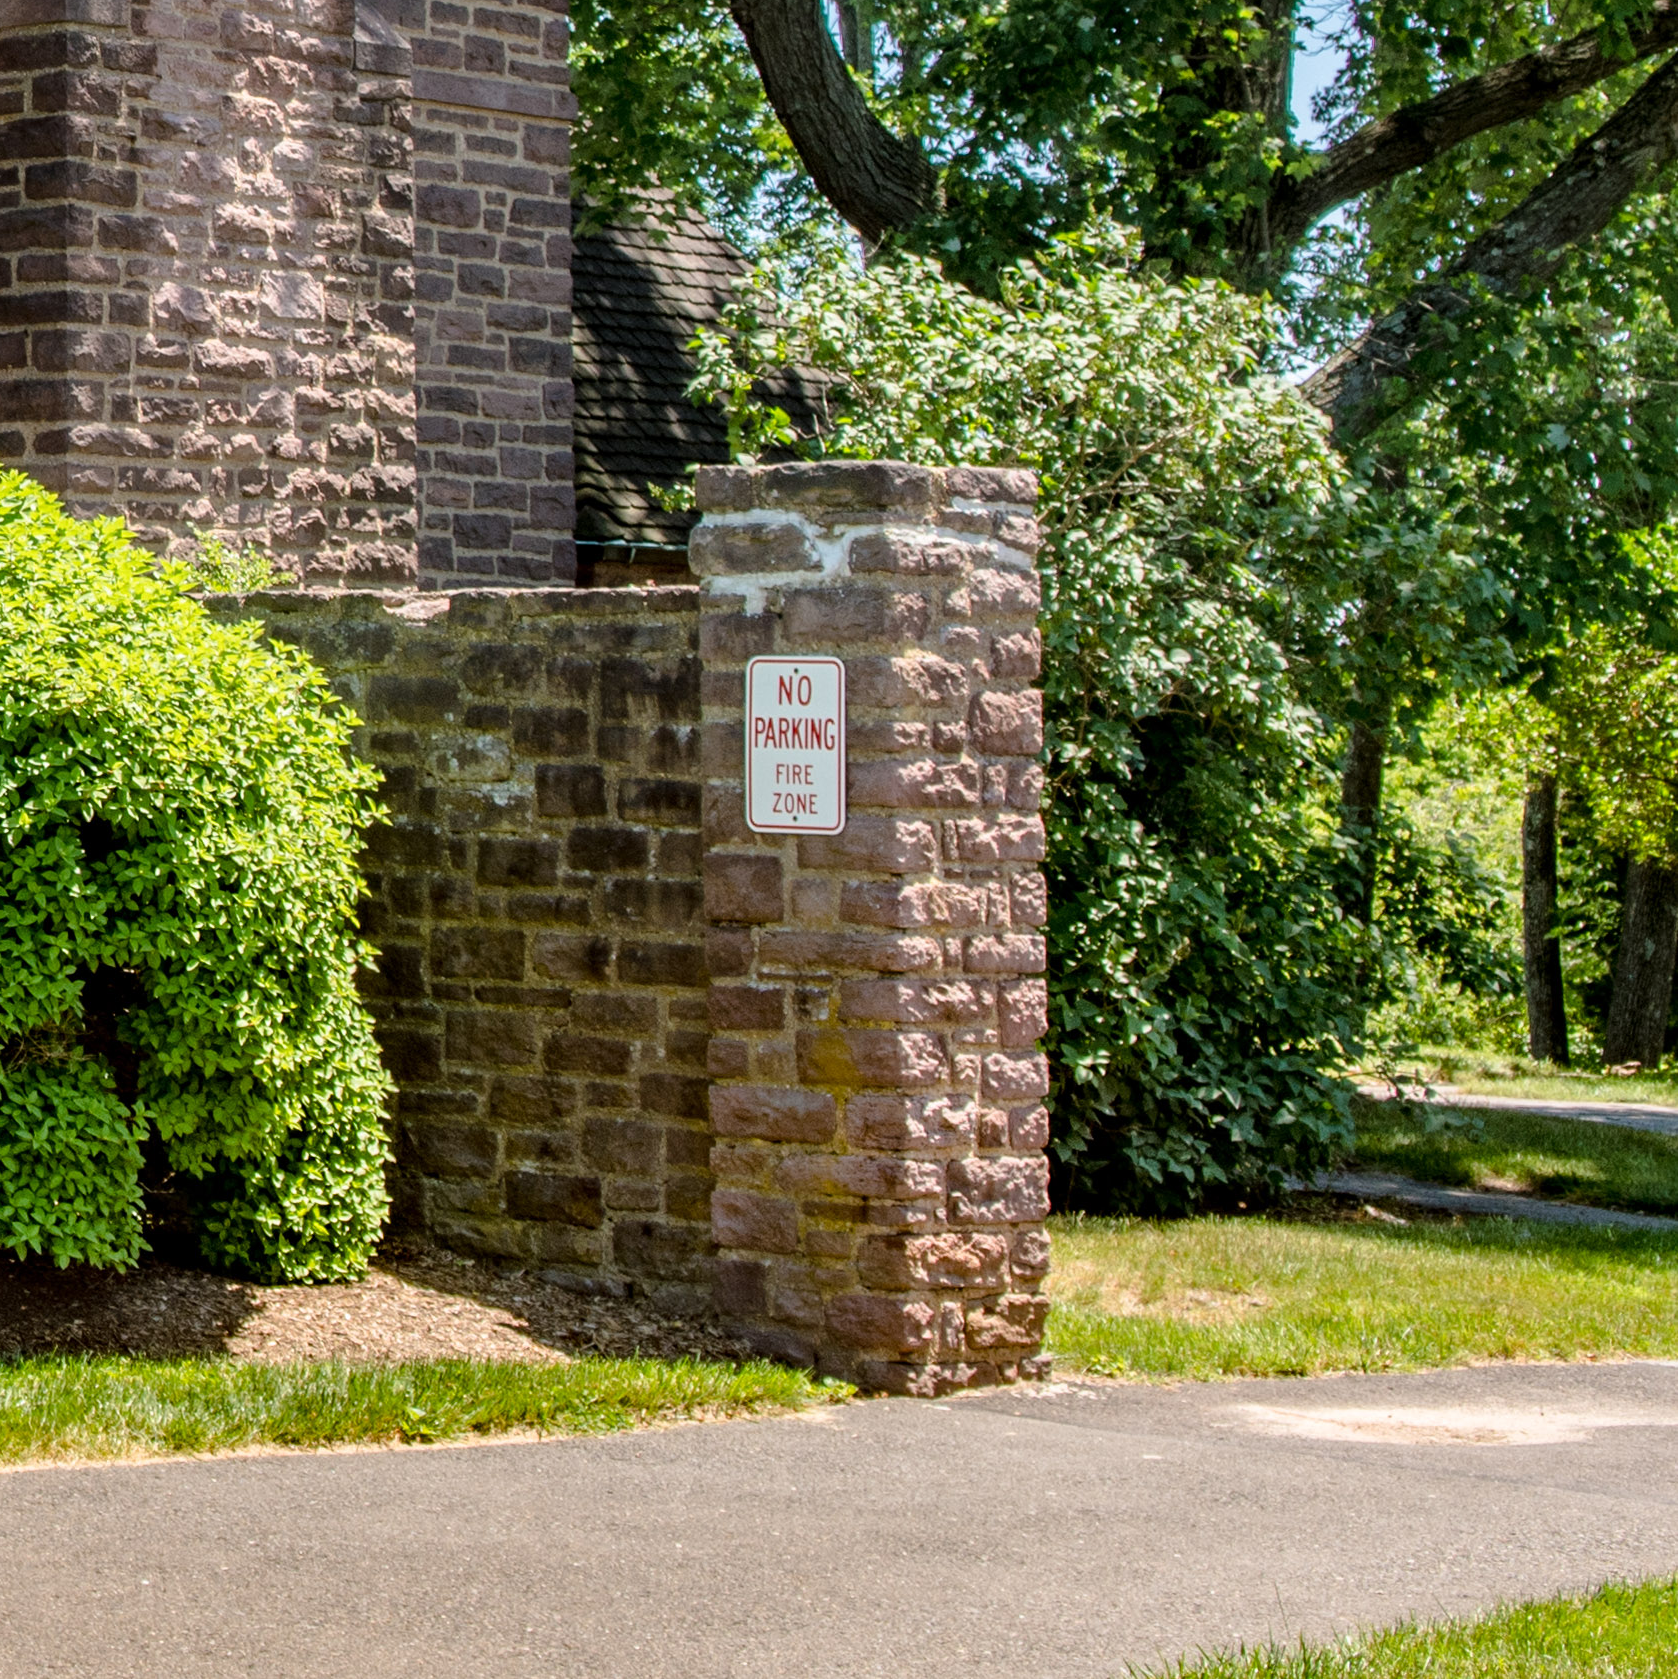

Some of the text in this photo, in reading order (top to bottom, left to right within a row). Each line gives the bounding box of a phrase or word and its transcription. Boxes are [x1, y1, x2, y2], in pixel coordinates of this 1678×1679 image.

[778, 676, 812, 705] NO
[755, 717, 835, 750] PARKING
[776, 764, 814, 785] FIRE
[772, 792, 818, 815] ZONE
